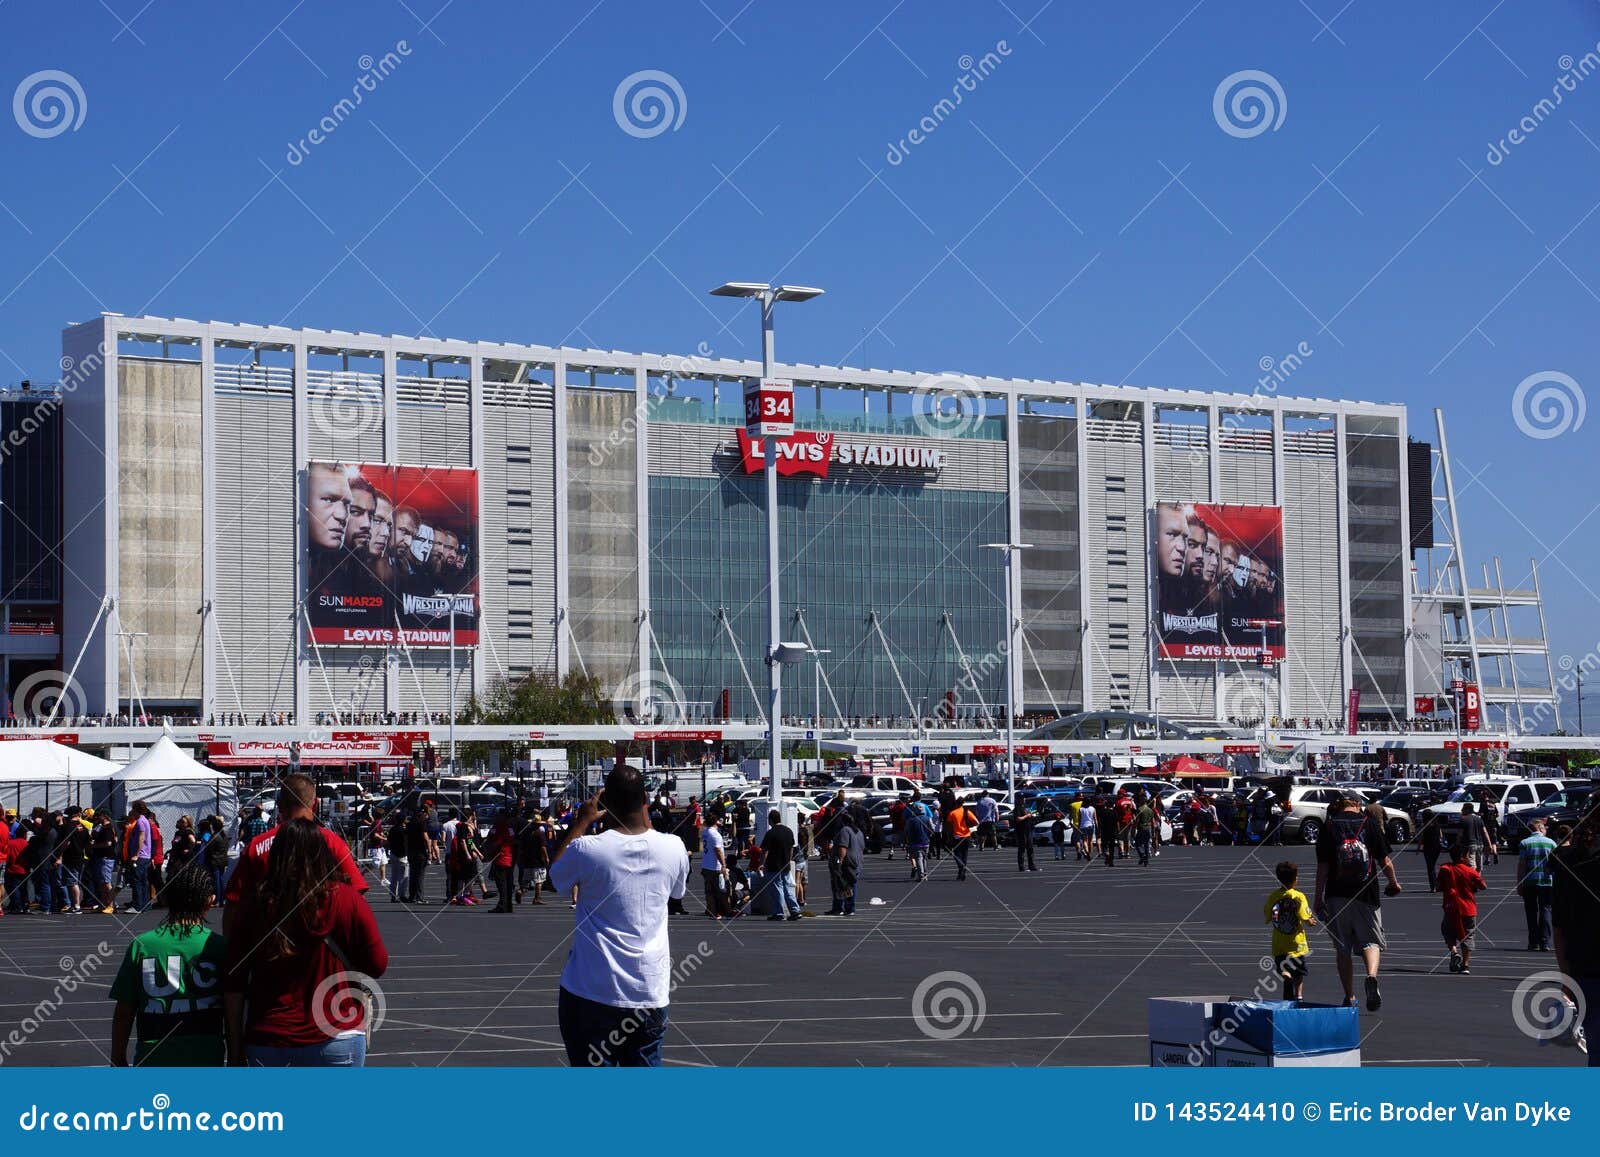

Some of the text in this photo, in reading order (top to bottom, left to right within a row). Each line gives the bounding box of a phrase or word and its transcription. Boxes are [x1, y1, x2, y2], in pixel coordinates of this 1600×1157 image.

[764, 397, 791, 416] 34
[838, 443, 938, 468] STADIUM
[1467, 692, 1478, 710] B
[238, 741, 381, 750] OFFICIAL MERCHANDISE
